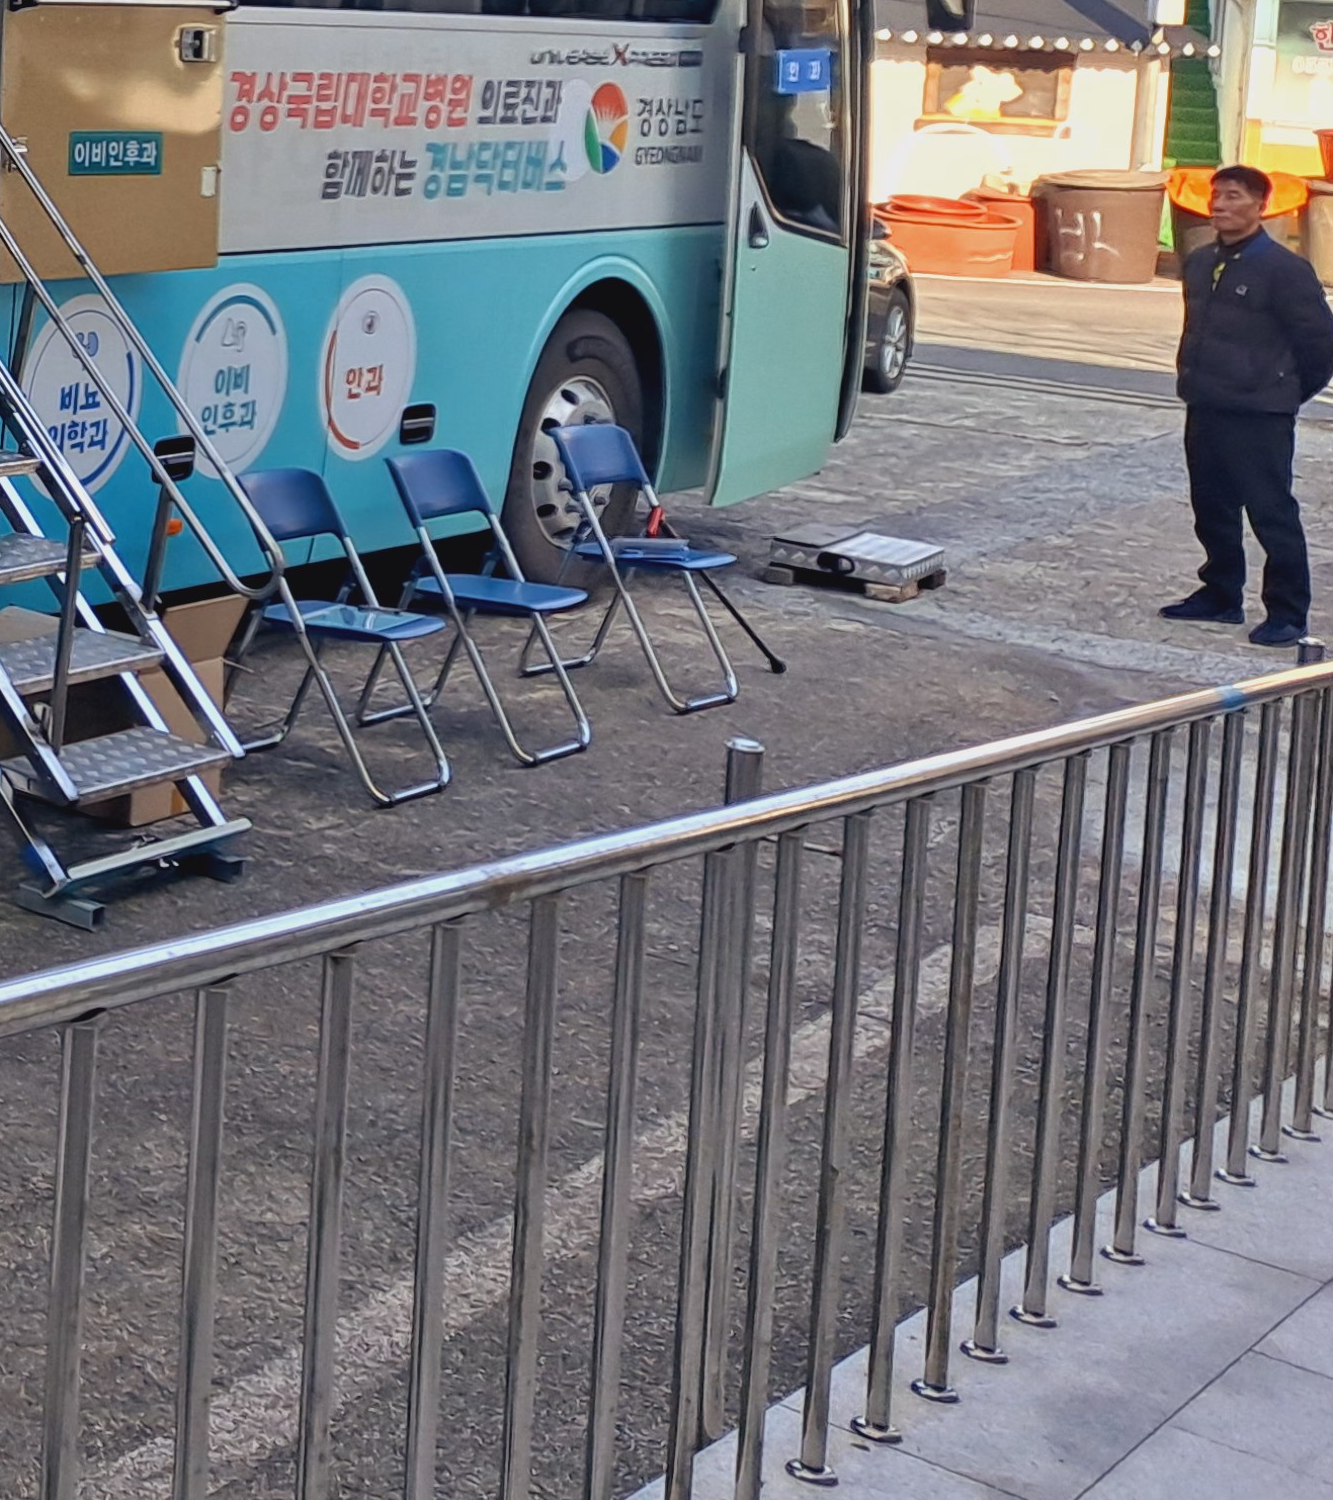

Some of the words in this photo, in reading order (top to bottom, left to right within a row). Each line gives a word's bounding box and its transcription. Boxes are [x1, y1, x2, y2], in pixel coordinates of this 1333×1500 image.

[229, 71, 473, 132] 경상국립대학교병원
[477, 80, 564, 125] 의료진과
[636, 98, 704, 137] 경상남도
[74, 141, 157, 167] 이비인후과
[321, 148, 418, 200] 함께하는
[423, 140, 568, 200] 경남닥터버스
[215, 364, 251, 396] 이비
[345, 363, 385, 399] 안과
[59, 382, 101, 415] 비뇨
[201, 399, 257, 436] 인후과
[48, 418, 108, 454] 의학과
